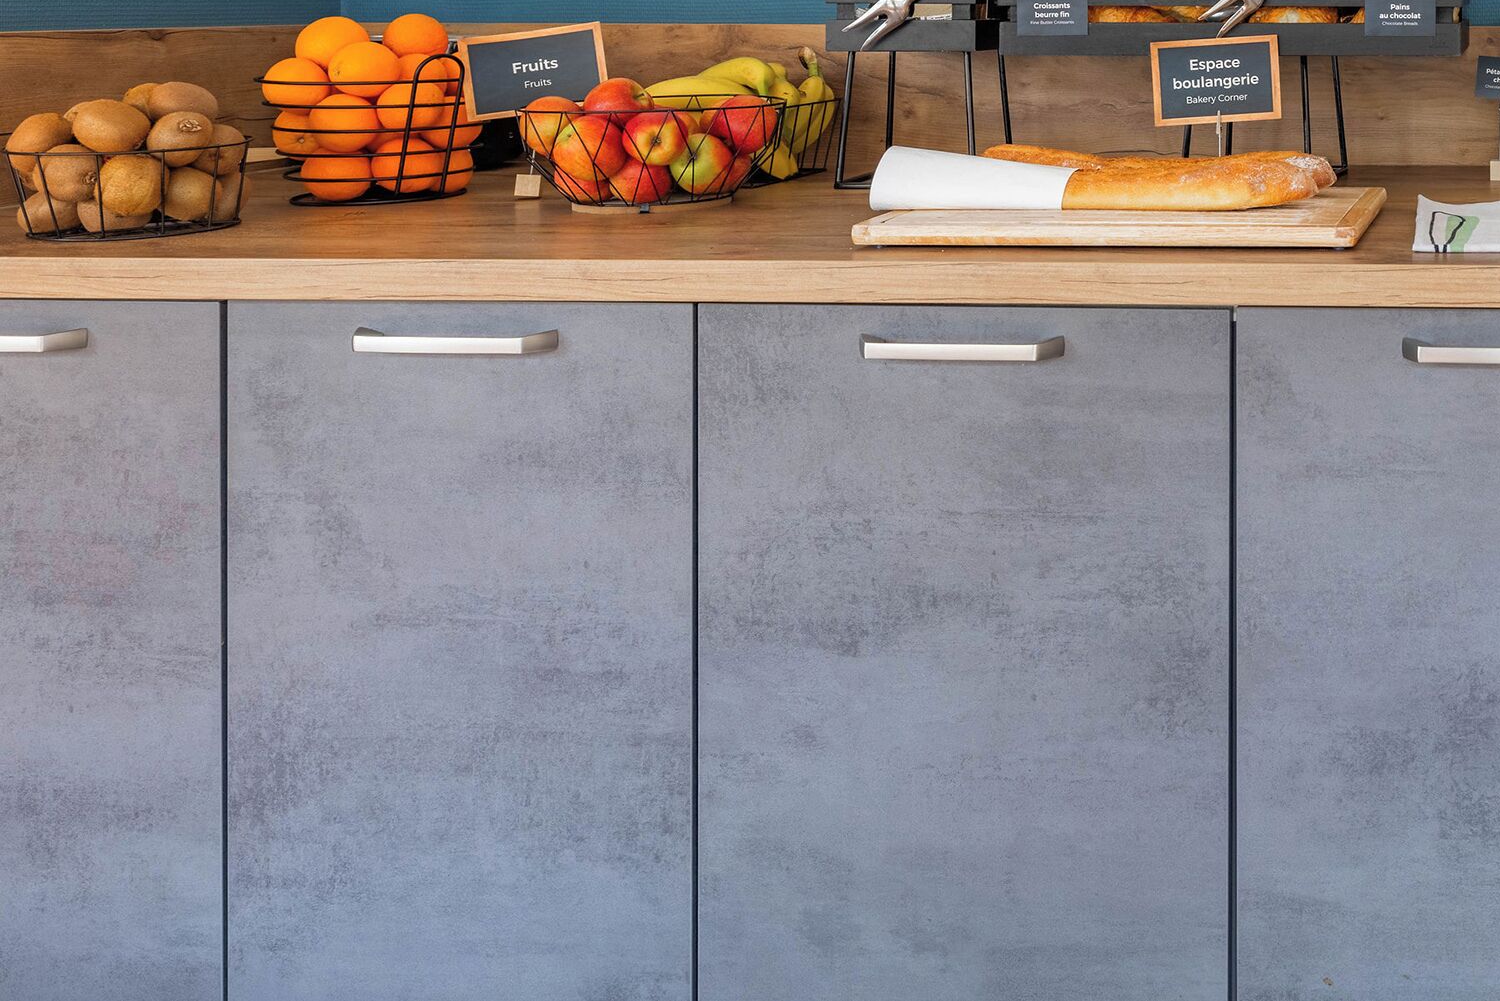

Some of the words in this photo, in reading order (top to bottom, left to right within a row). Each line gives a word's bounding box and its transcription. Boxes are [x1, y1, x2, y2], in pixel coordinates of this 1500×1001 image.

[1060, 10, 1070, 18] fin
[512, 58, 559, 74] Fruits
[1189, 58, 1240, 72] Espace
[524, 79, 552, 89] Fruits
[1172, 72, 1260, 90] boulangerie
[1186, 96, 1217, 105] Bakery
[1217, 93, 1248, 102] Corner
